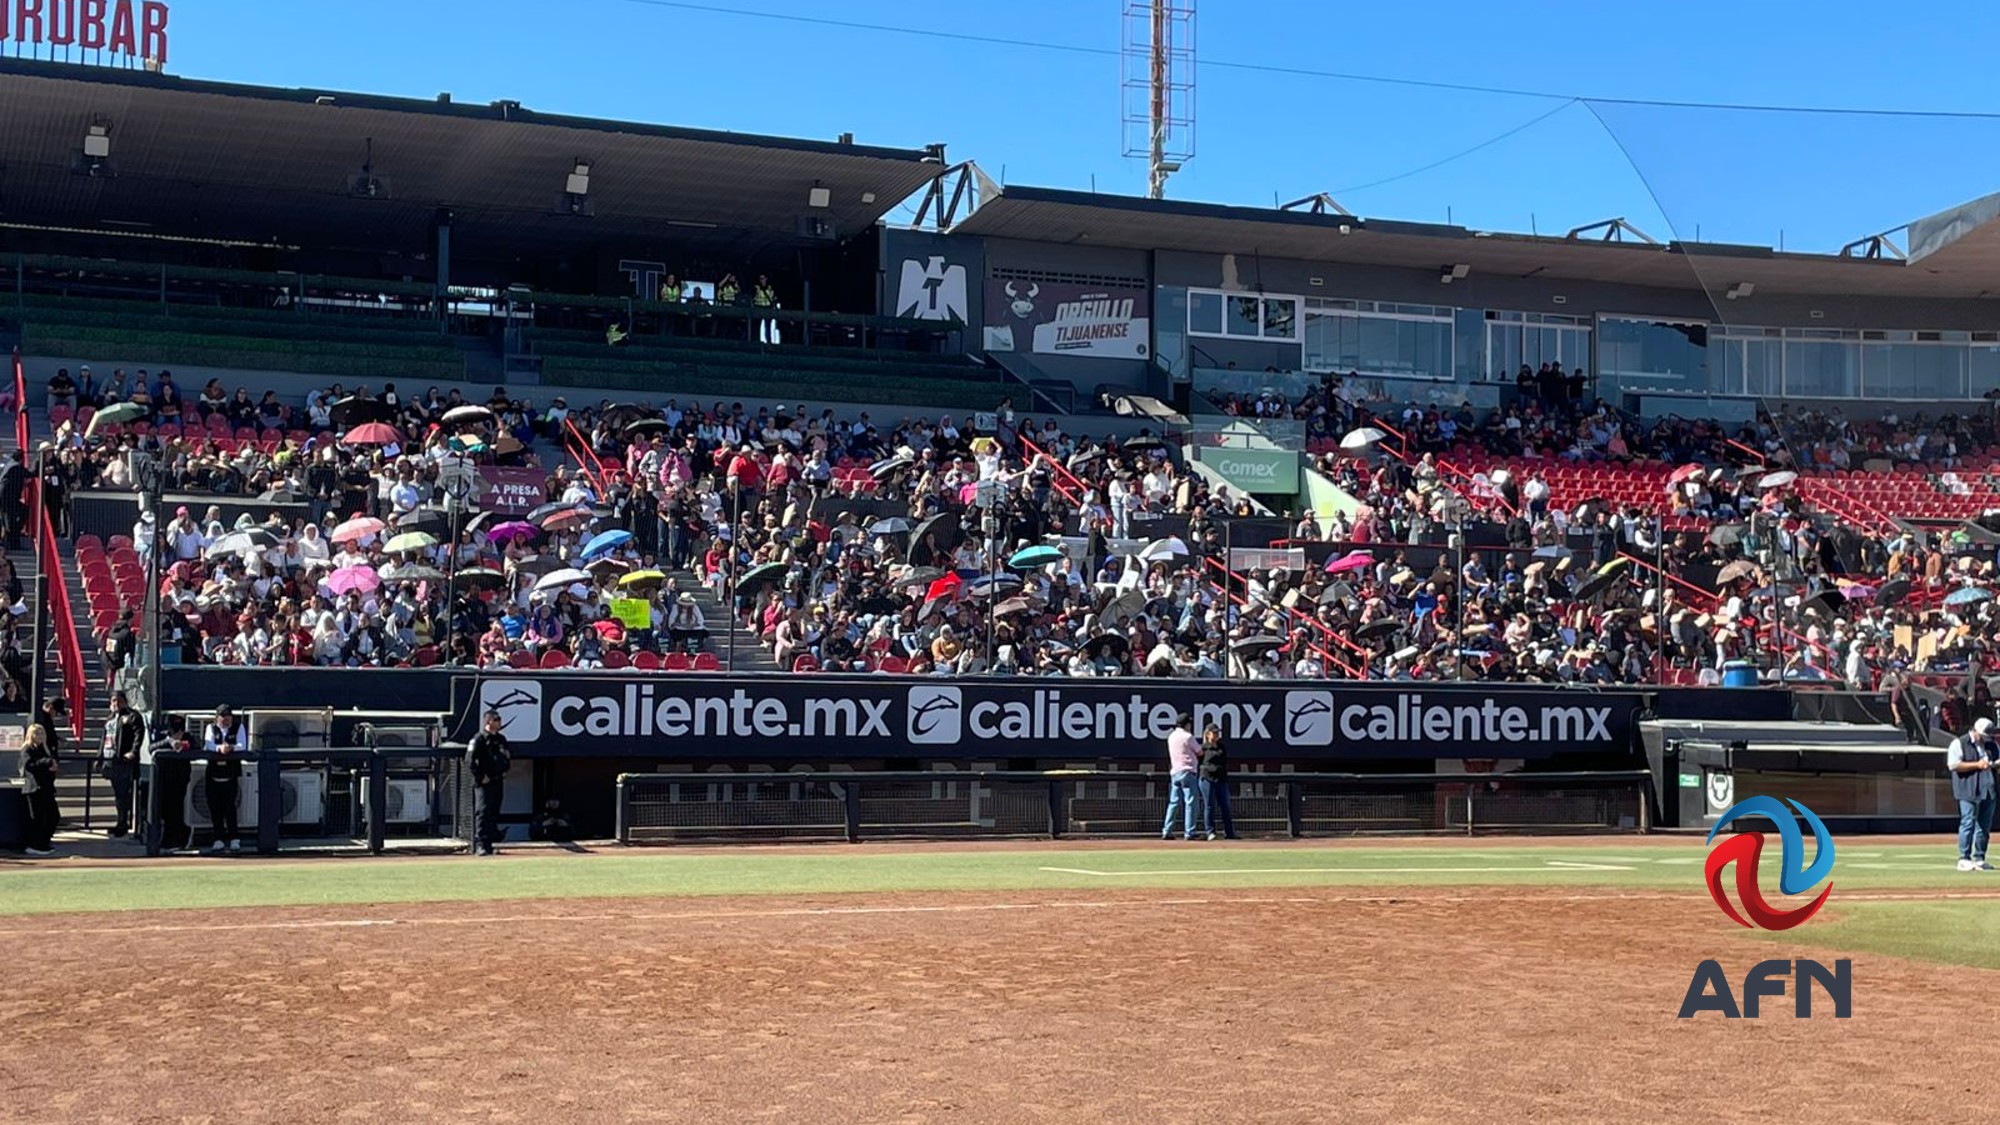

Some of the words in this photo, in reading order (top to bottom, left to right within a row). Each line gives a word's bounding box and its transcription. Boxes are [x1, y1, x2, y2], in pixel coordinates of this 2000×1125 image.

[0, 0, 168, 64] ROBAR
[1055, 299, 1134, 322] ORGULLO
[1056, 323, 1129, 342] TIJUANENSE
[1219, 459, 1281, 477] Comex
[491, 483, 500, 494] A
[503, 484, 540, 496] PRESA
[549, 684, 892, 737] caliente.mx
[1339, 695, 1613, 741] caliente.mx
